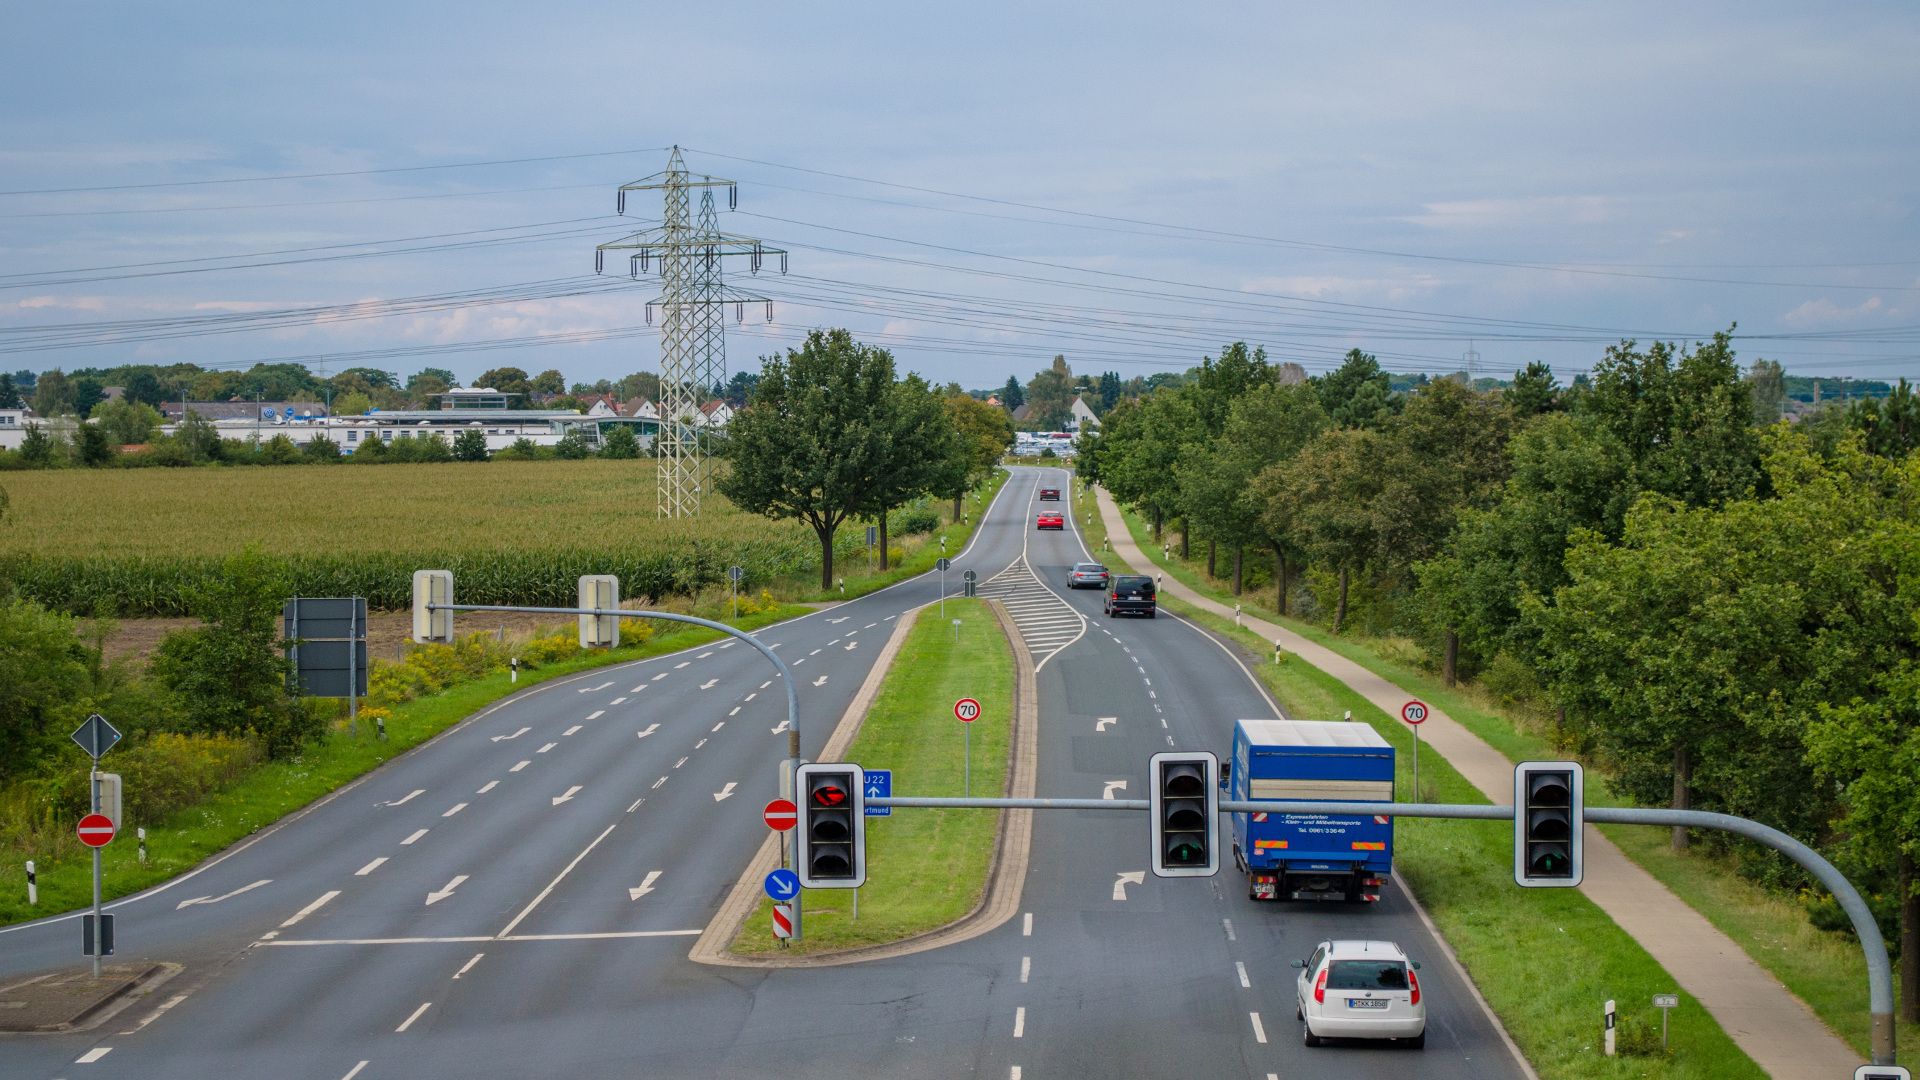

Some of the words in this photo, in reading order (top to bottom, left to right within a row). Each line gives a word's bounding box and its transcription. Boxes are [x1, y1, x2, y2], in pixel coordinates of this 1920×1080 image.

[961, 705, 976, 716] 70
[1408, 707, 1423, 719] 70
[872, 775, 885, 784] 22
